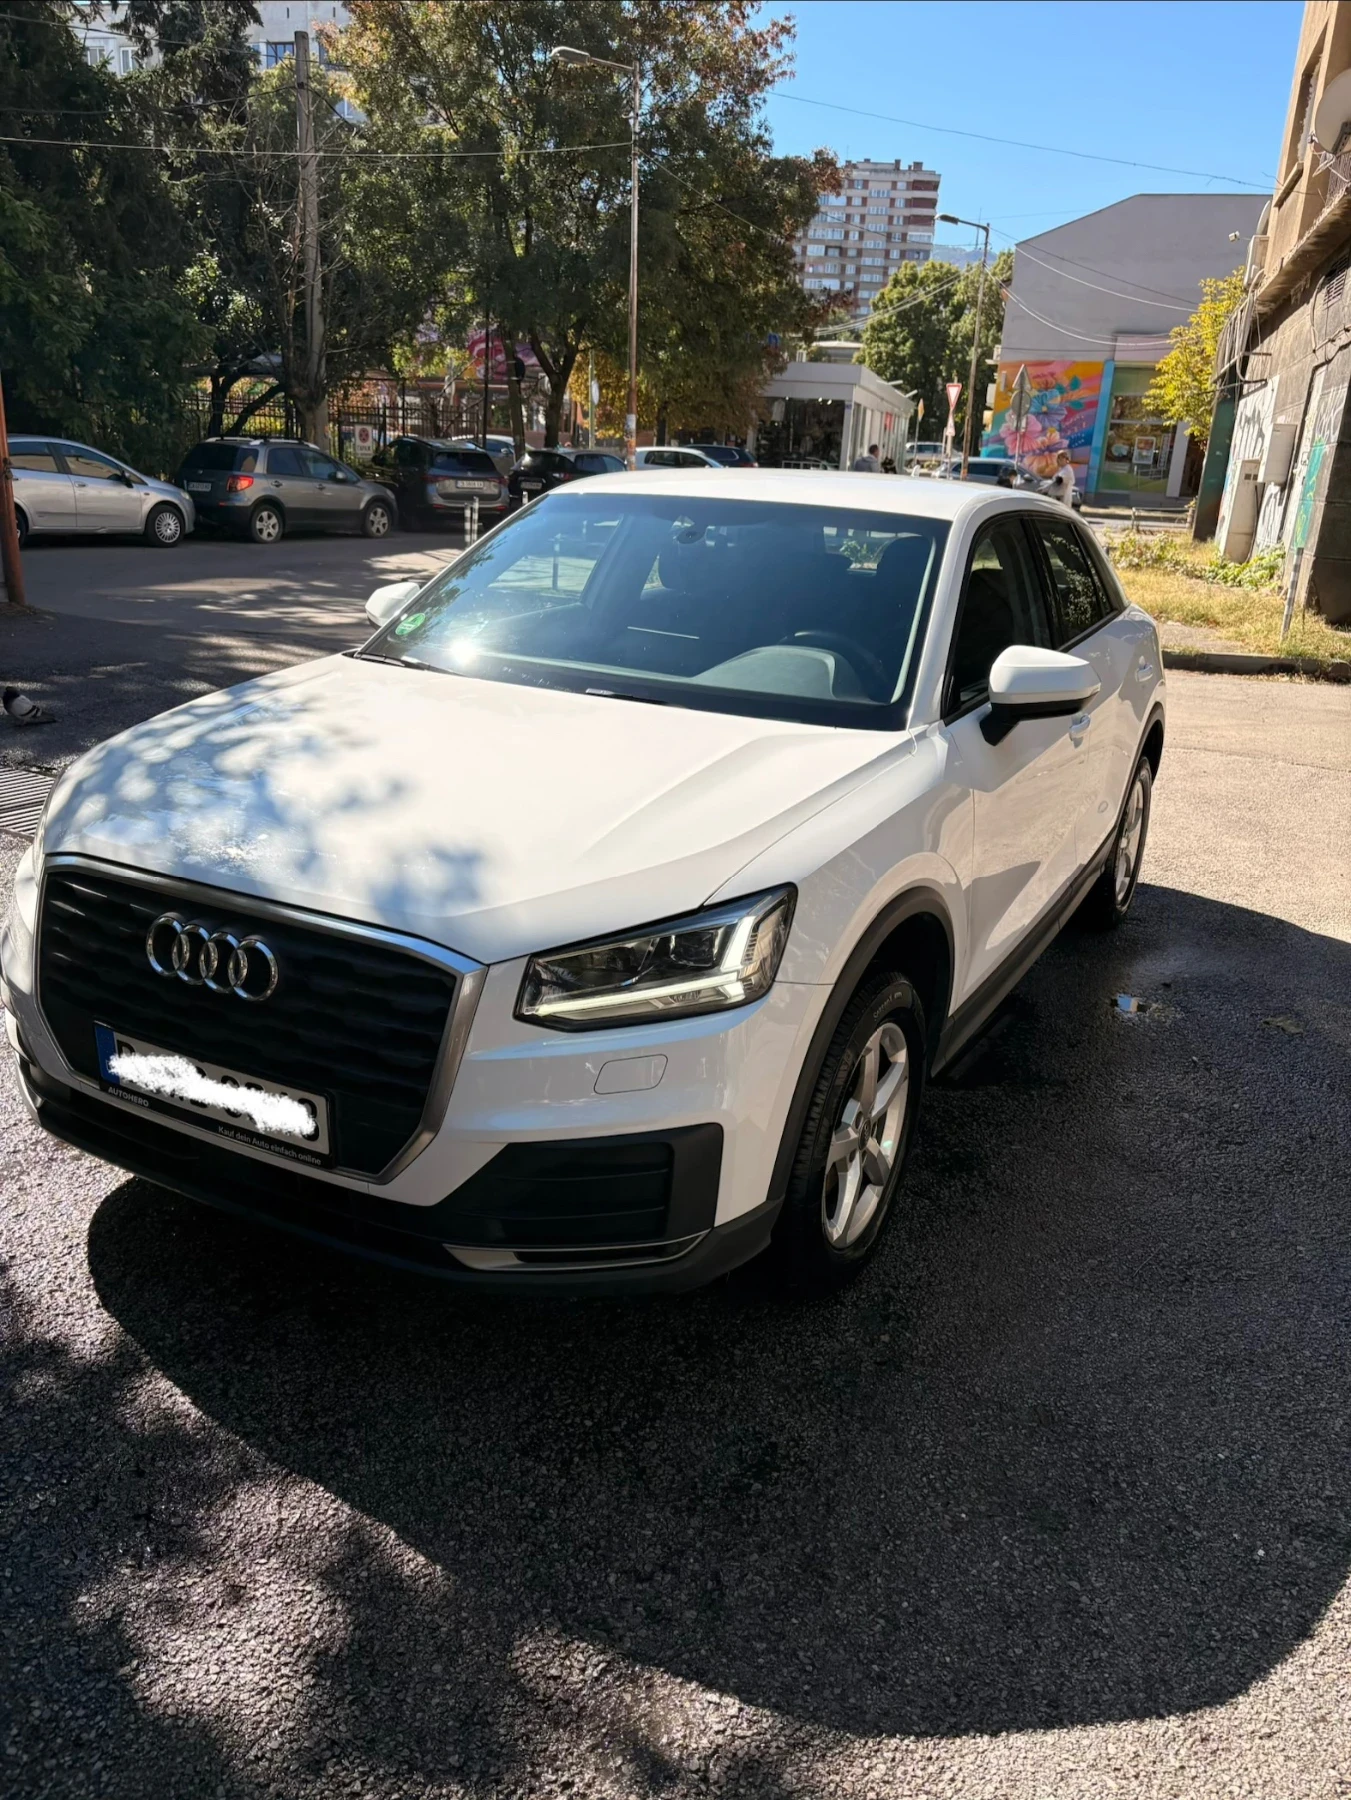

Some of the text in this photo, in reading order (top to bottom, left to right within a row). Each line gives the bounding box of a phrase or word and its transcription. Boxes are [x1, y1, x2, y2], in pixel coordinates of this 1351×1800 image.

[108, 1086, 149, 1107] AUTOHERO
[218, 1126, 321, 1165] Kauf dein Auto einfach online
